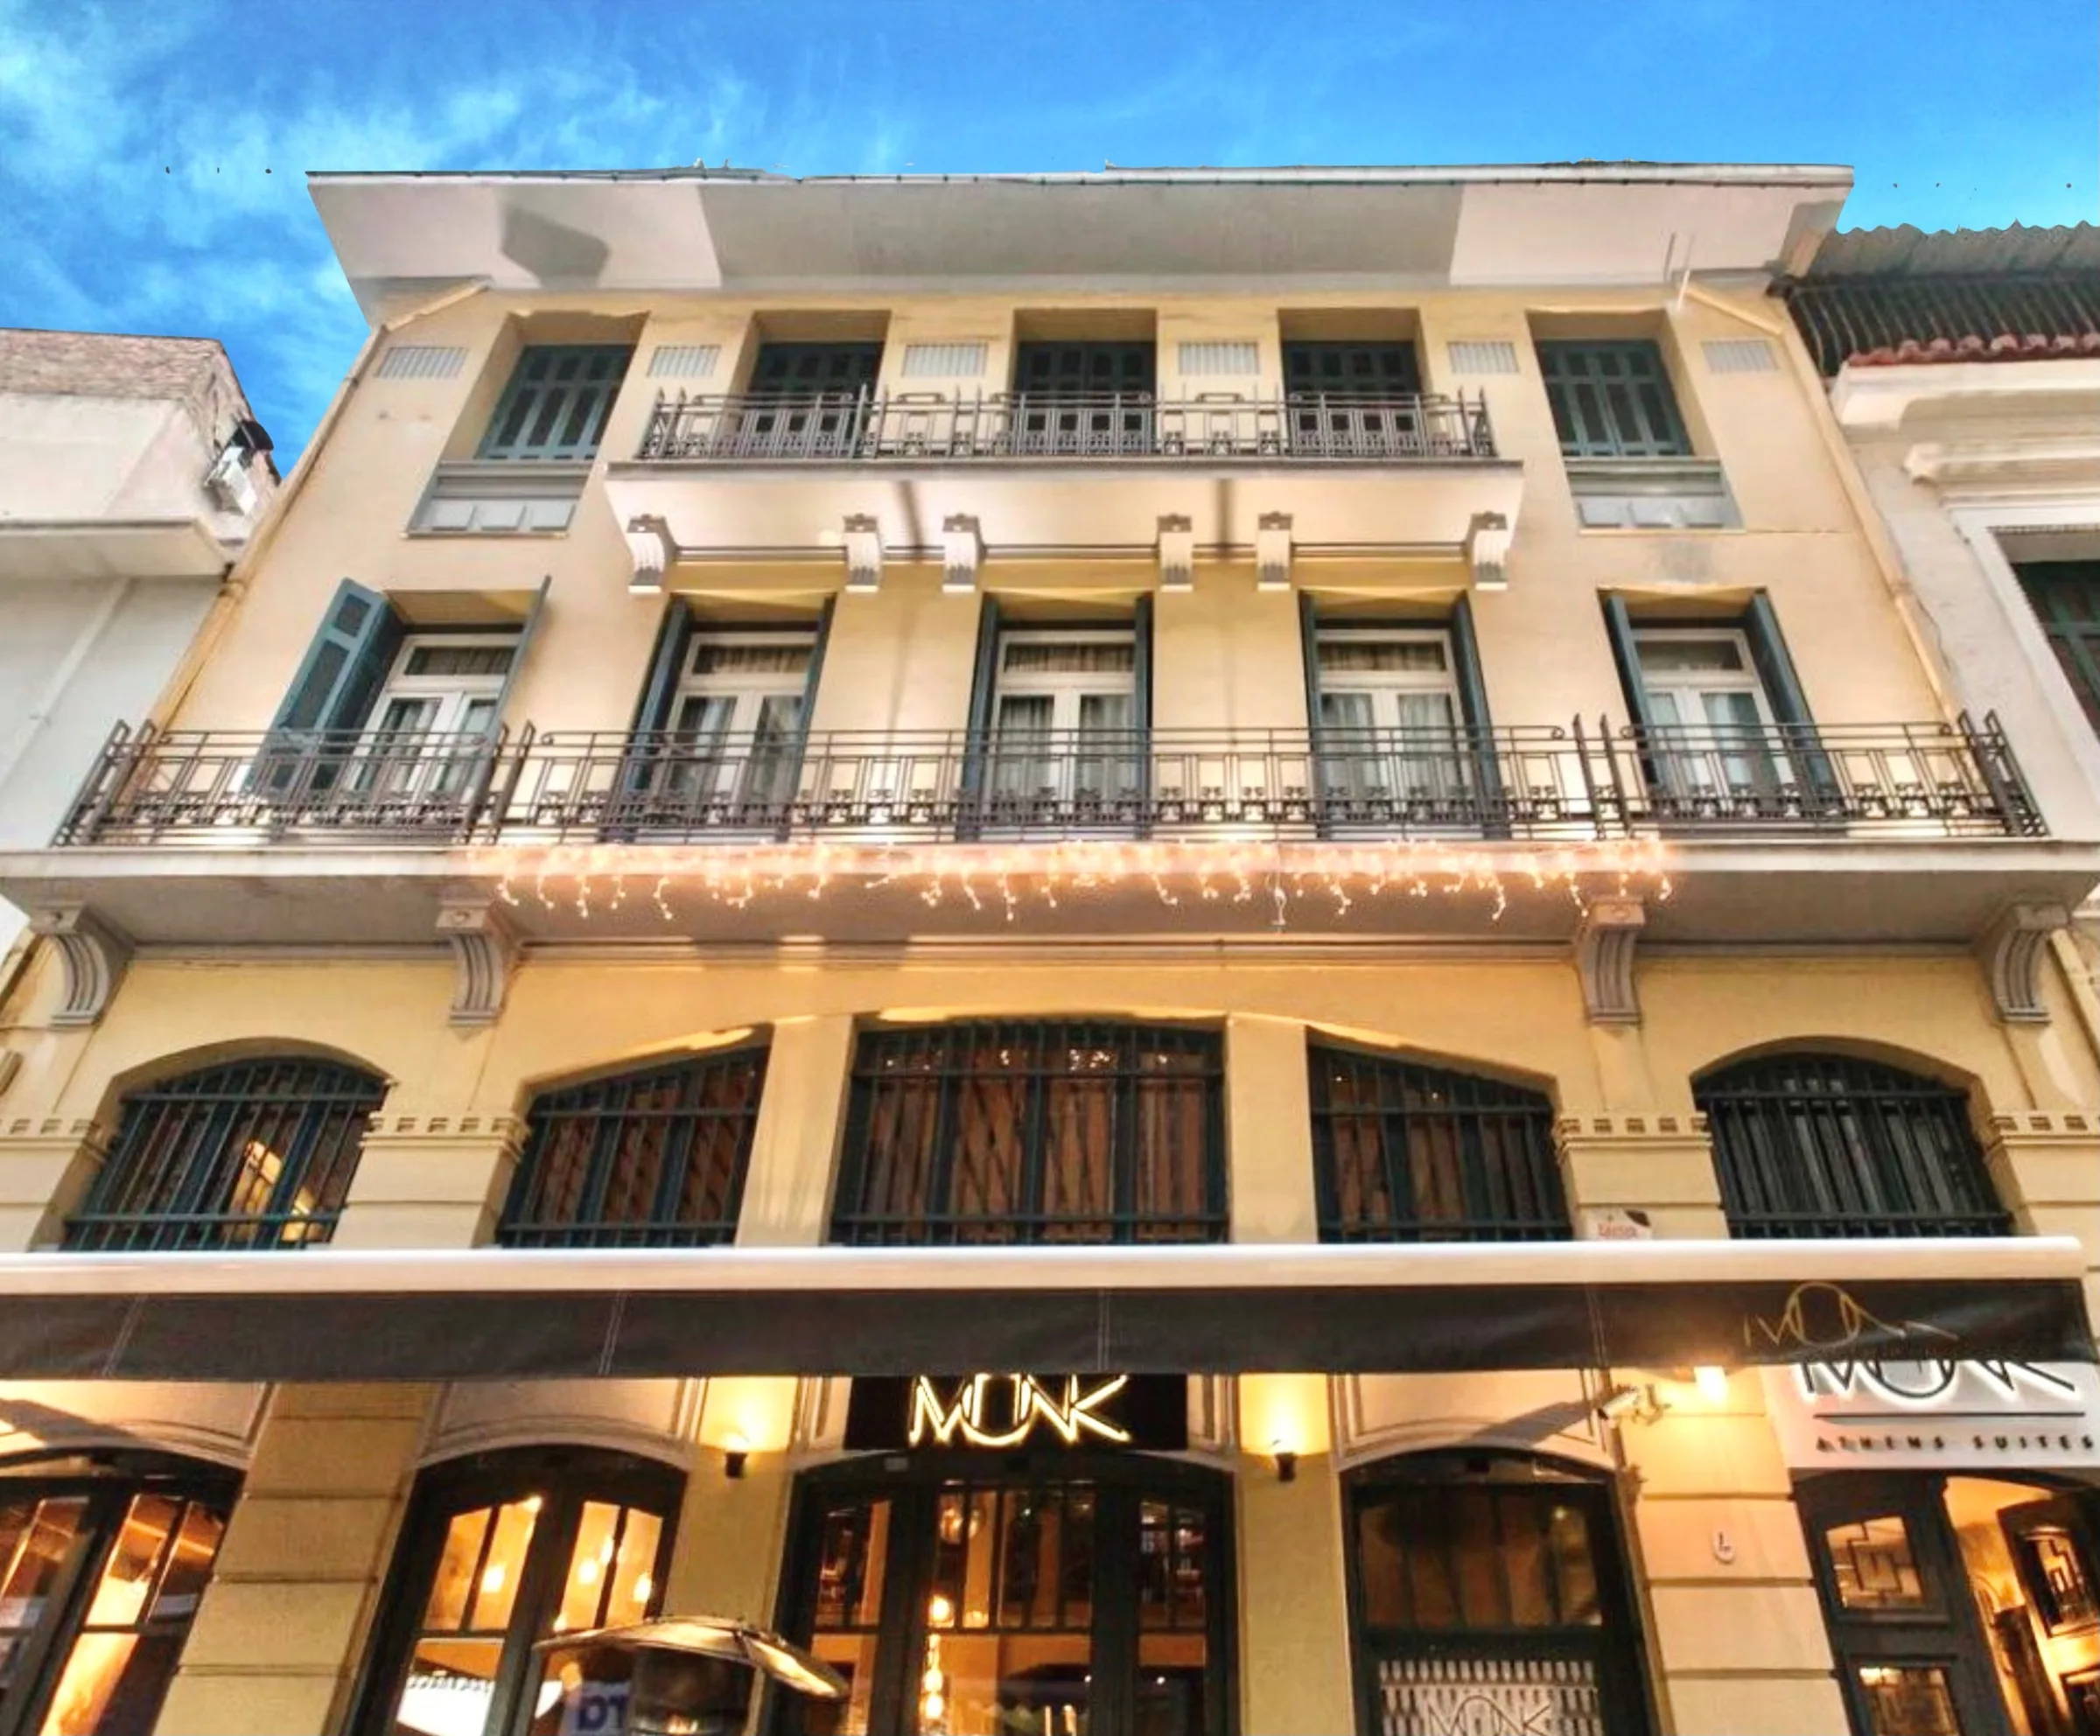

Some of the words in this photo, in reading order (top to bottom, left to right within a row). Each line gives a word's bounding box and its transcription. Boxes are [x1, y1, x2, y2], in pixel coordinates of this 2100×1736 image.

[908, 1373, 1130, 1446] MONK
[1816, 1435, 1945, 1451] ATHENS
[1971, 1434, 2093, 1451] SUITES
